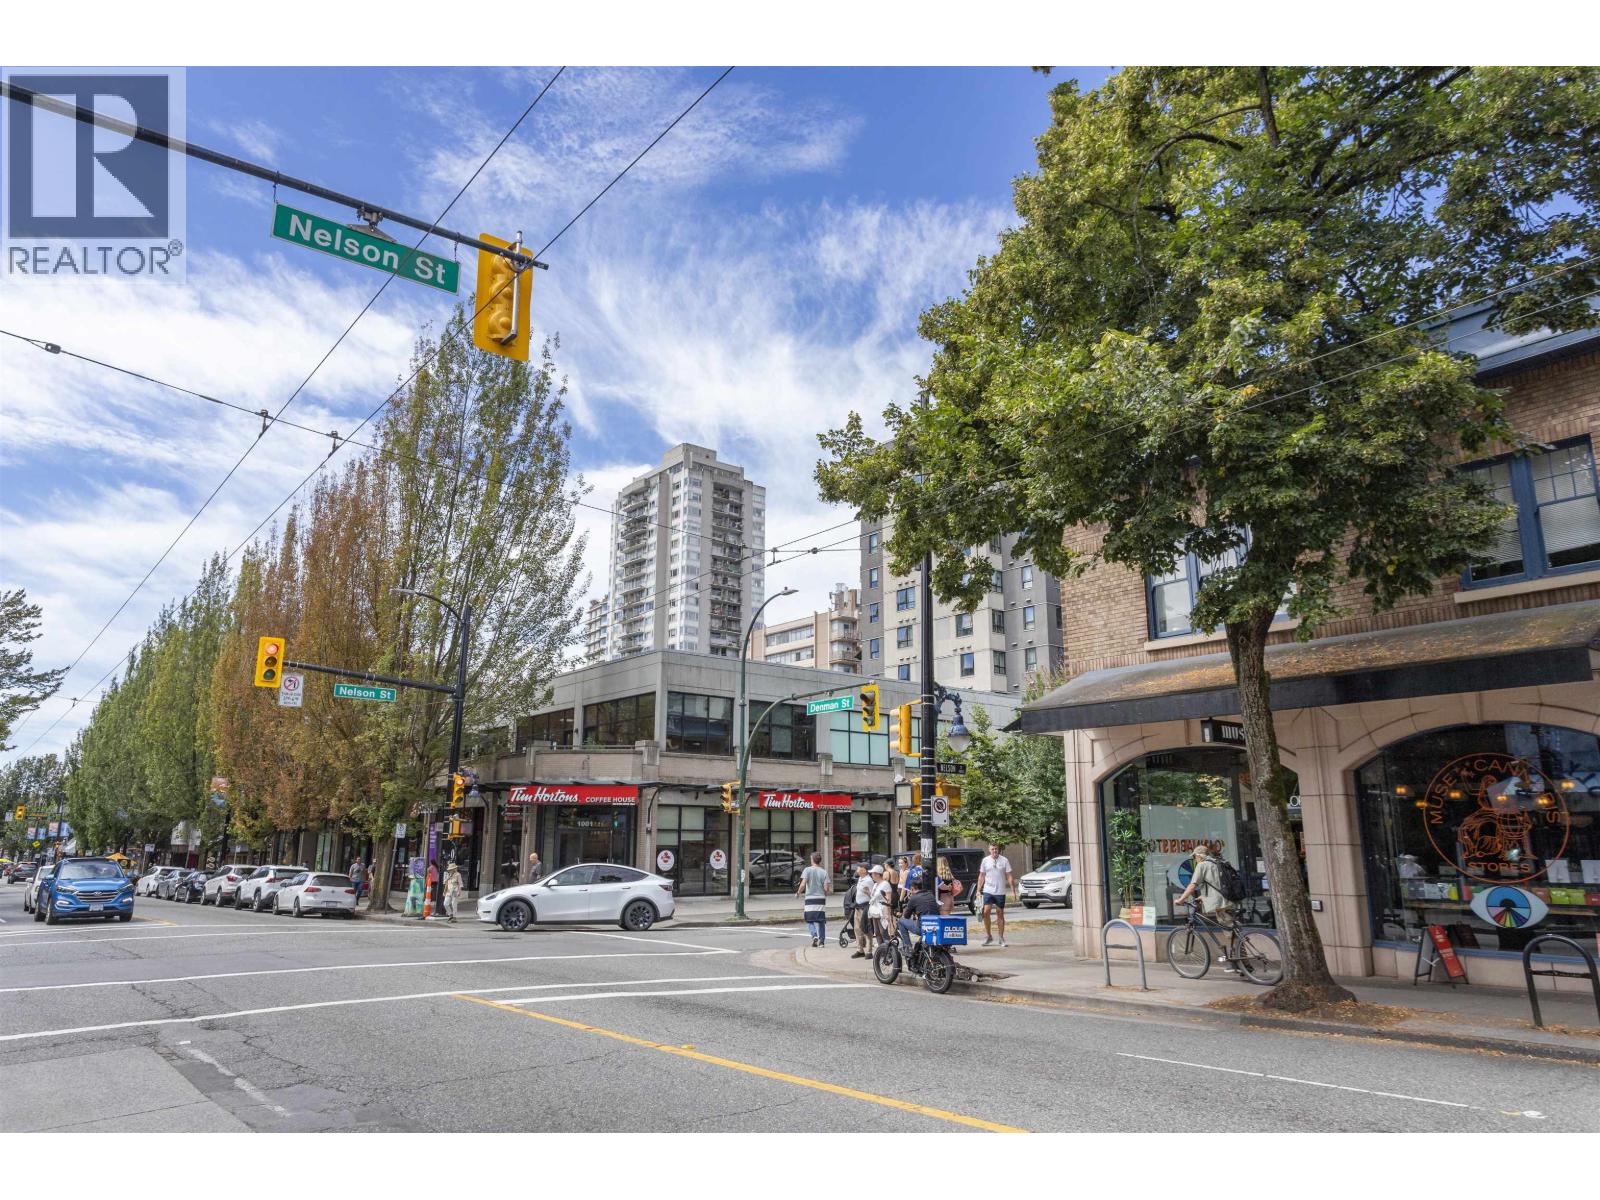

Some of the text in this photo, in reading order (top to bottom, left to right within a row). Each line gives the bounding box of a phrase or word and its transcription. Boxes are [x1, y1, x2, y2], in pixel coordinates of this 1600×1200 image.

[289, 214, 446, 285] Nelson St
[340, 686, 391, 699] Nelson St
[810, 699, 850, 713] Denman St
[510, 787, 533, 803] Tim
[533, 786, 579, 803] Hortons
[763, 794, 781, 808] Tim
[781, 793, 815, 809] Hortons
[1430, 773, 1457, 824] MUSE
[1467, 861, 1531, 874] STORES
